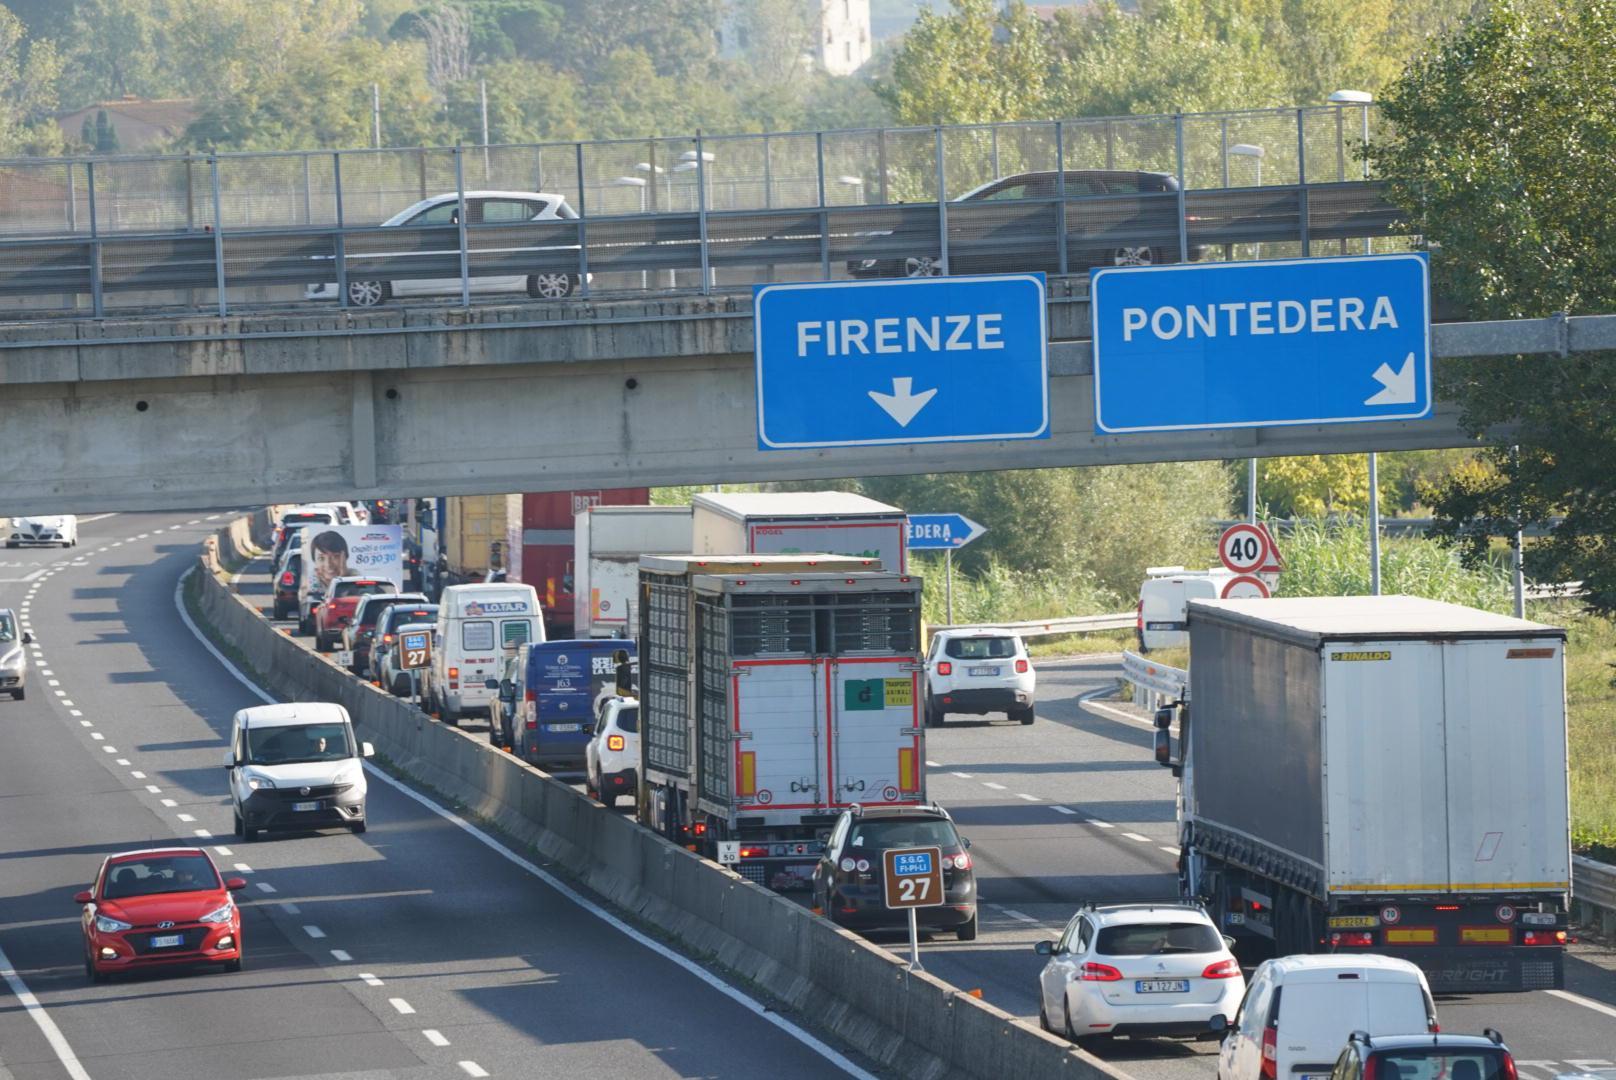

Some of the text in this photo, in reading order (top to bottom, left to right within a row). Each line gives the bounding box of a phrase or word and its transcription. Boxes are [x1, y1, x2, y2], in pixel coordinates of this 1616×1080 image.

[1122, 295, 1399, 342] PONTEDERA
[797, 313, 1005, 357] FIRENZE
[574, 495, 599, 510] BRT
[907, 523, 951, 539] EDERA
[1229, 537, 1258, 561] 40
[408, 651, 426, 666] 27
[723, 853, 735, 862] 50
[898, 877, 931, 901] 27
